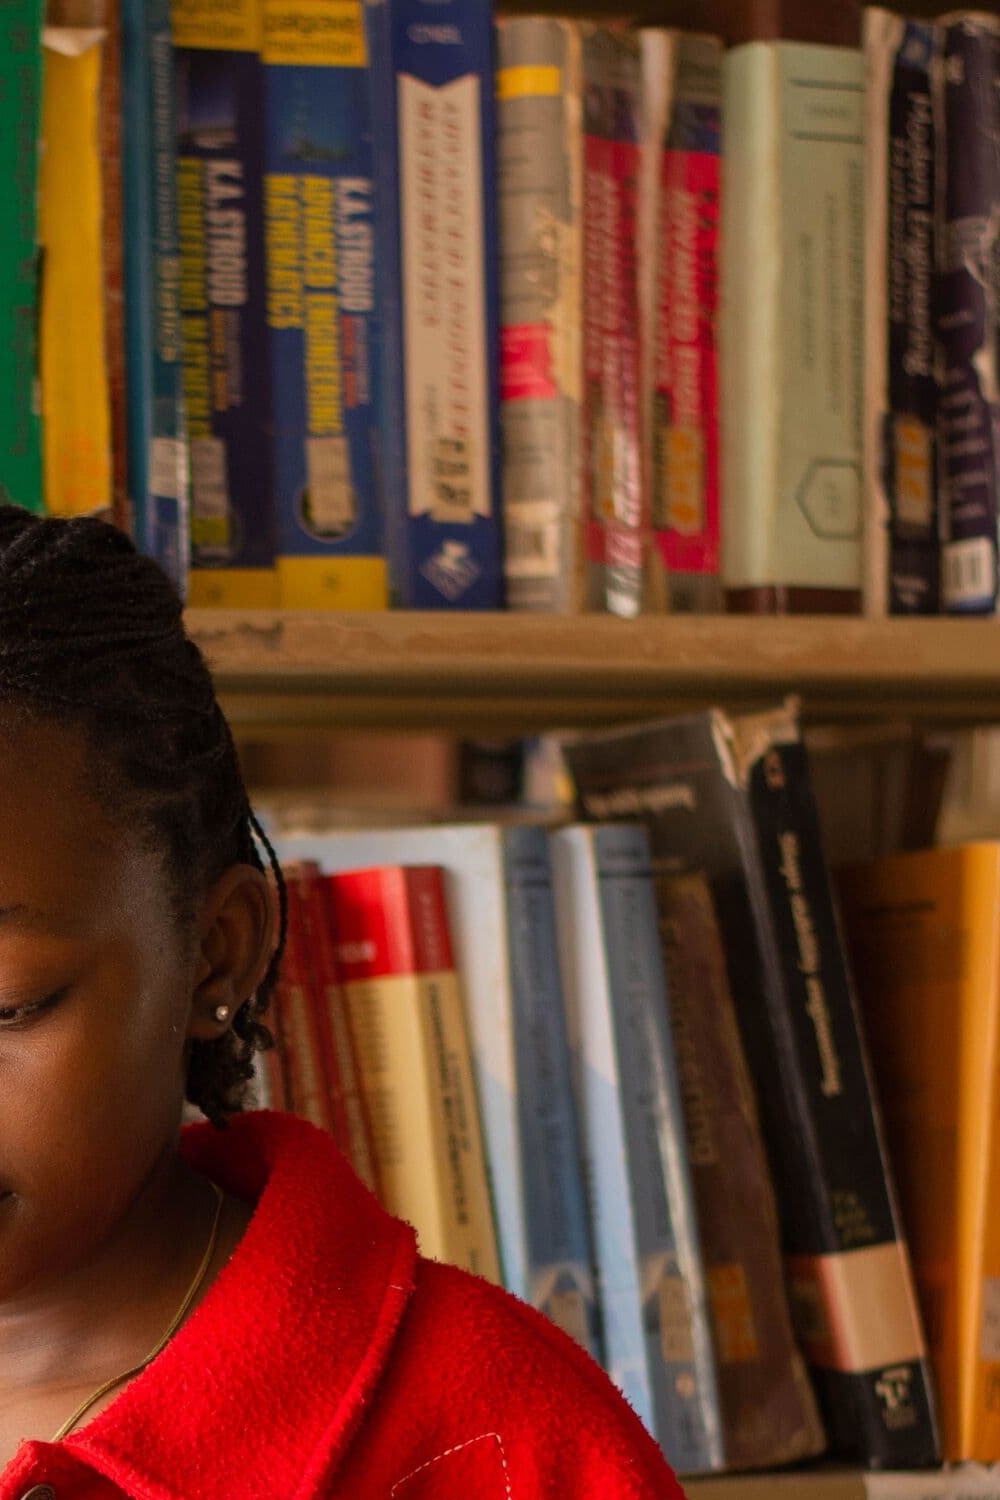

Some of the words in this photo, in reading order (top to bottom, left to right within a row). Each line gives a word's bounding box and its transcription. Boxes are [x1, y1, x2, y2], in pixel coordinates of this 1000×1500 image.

[207, 207, 247, 306] STROUD
[264, 173, 302, 329] MATHEMATICS
[303, 174, 337, 288] ADVANCED
[338, 221, 375, 312] STROUD
[303, 291, 341, 437] ENGINEERING
